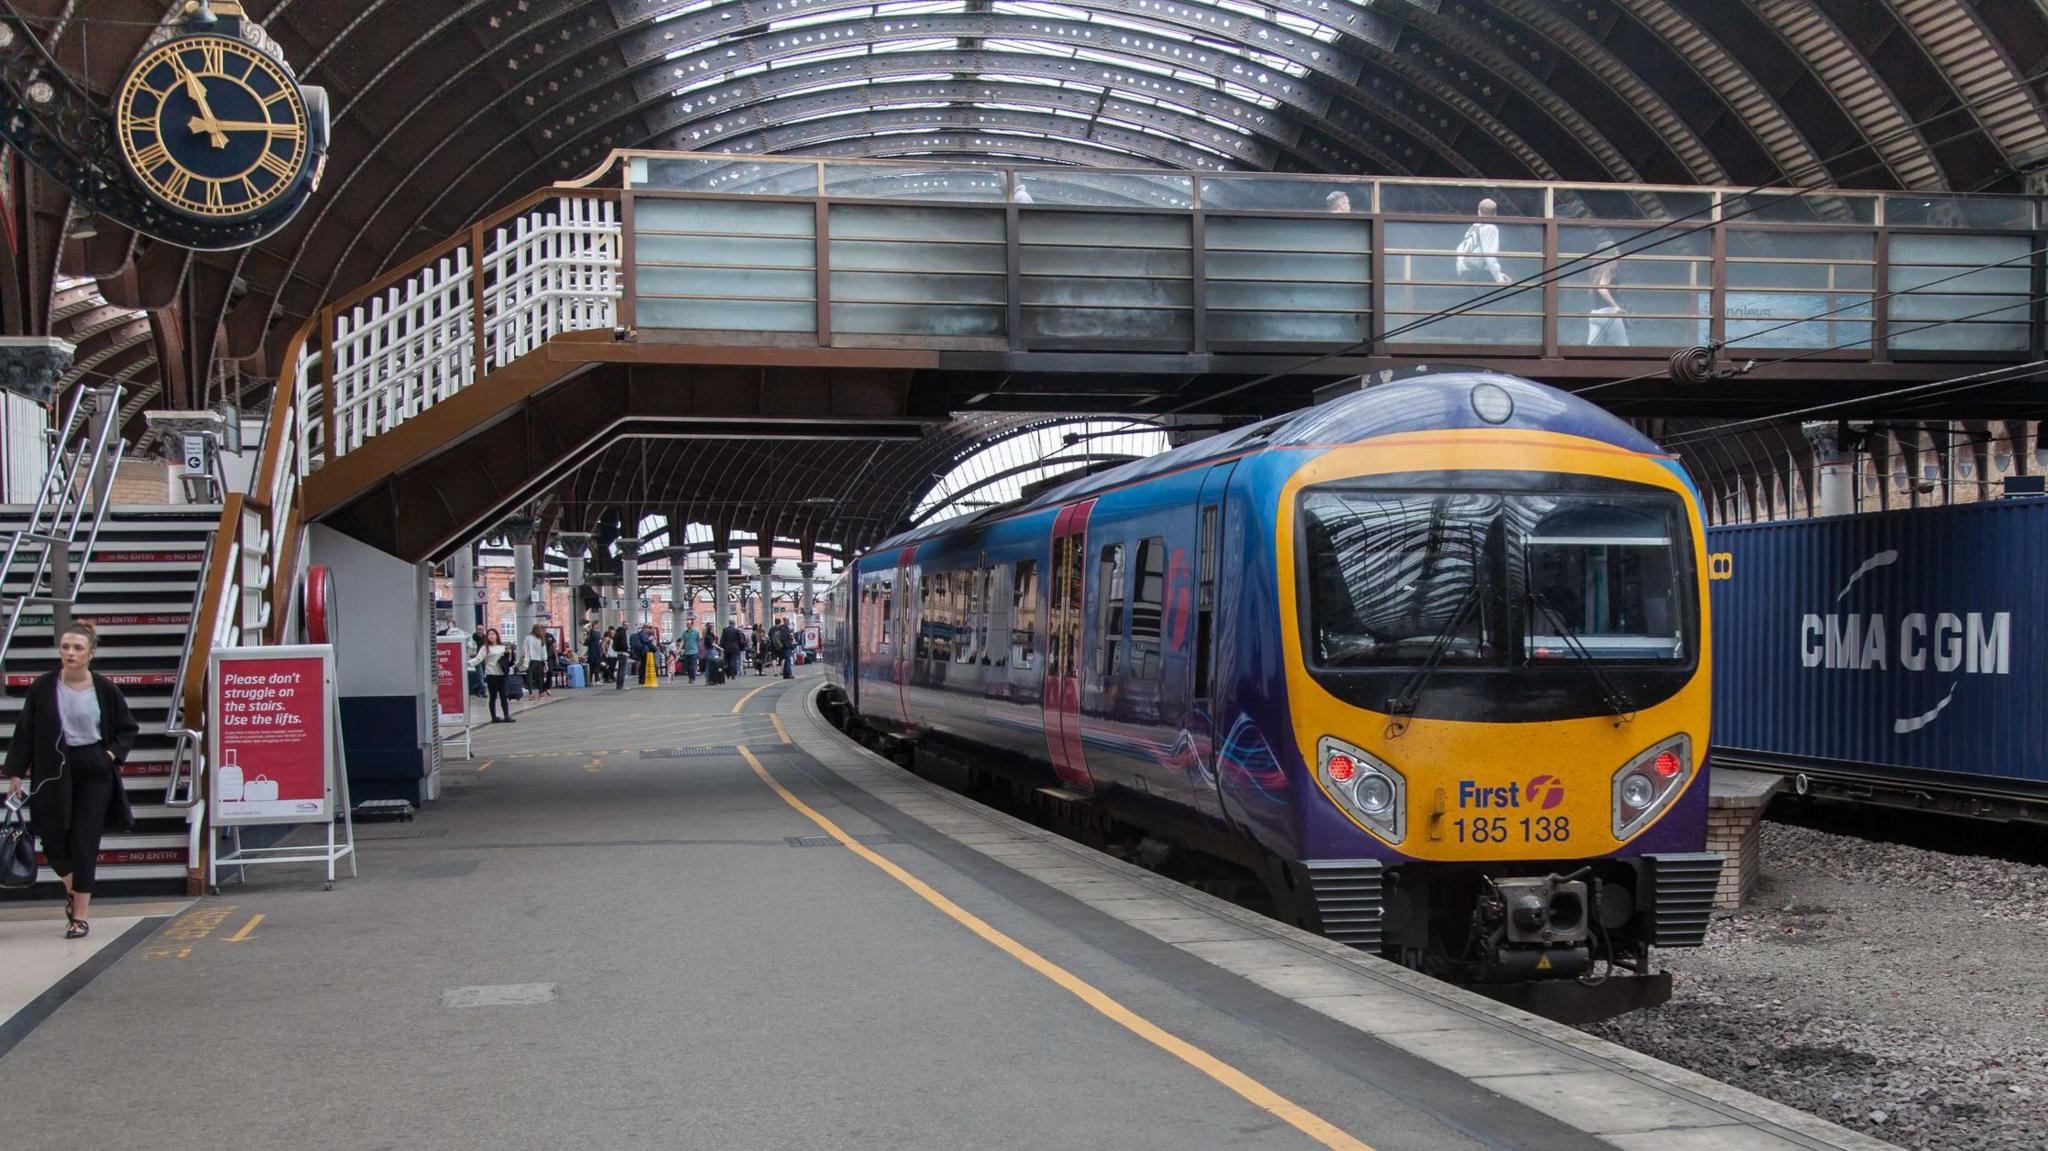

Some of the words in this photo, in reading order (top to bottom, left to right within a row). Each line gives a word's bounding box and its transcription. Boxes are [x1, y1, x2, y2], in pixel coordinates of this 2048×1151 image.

[1801, 613, 1887, 671] CMA
[1900, 612, 2010, 674] CGM
[224, 674, 265, 685] Please
[224, 687, 276, 700] struggle
[279, 688, 294, 697] on
[225, 701, 246, 711] the
[248, 700, 286, 711] stairs.
[224, 714, 248, 725] Use
[252, 714, 272, 725] the
[275, 712, 302, 726] lifts.
[1459, 780, 1519, 808] First
[1454, 817, 1507, 843] 185
[1520, 816, 1570, 842] 138
[147, 852, 177, 860] ENTRY
